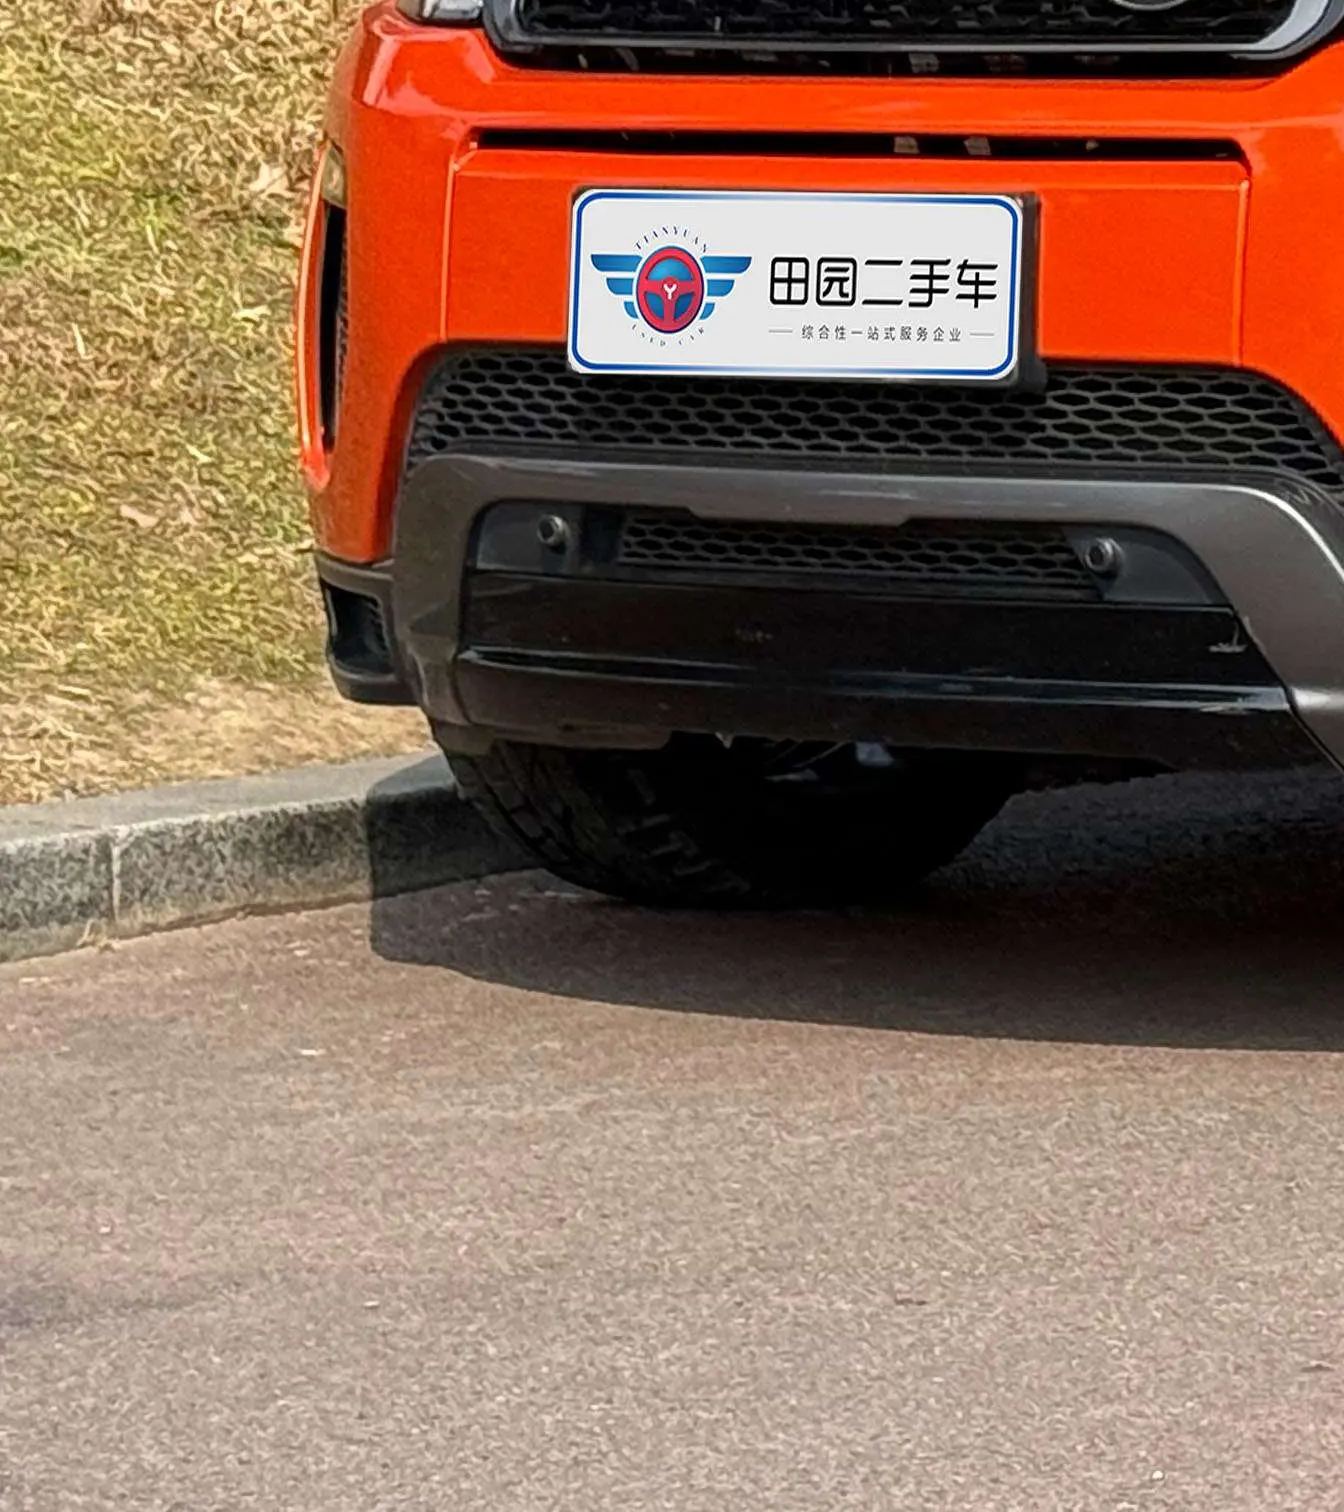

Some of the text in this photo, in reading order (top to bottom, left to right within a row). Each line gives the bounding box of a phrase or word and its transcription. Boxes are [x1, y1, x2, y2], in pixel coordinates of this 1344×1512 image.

[768, 256, 999, 309] 田园二手车
[801, 324, 962, 343] 综合性一站式服务企业
